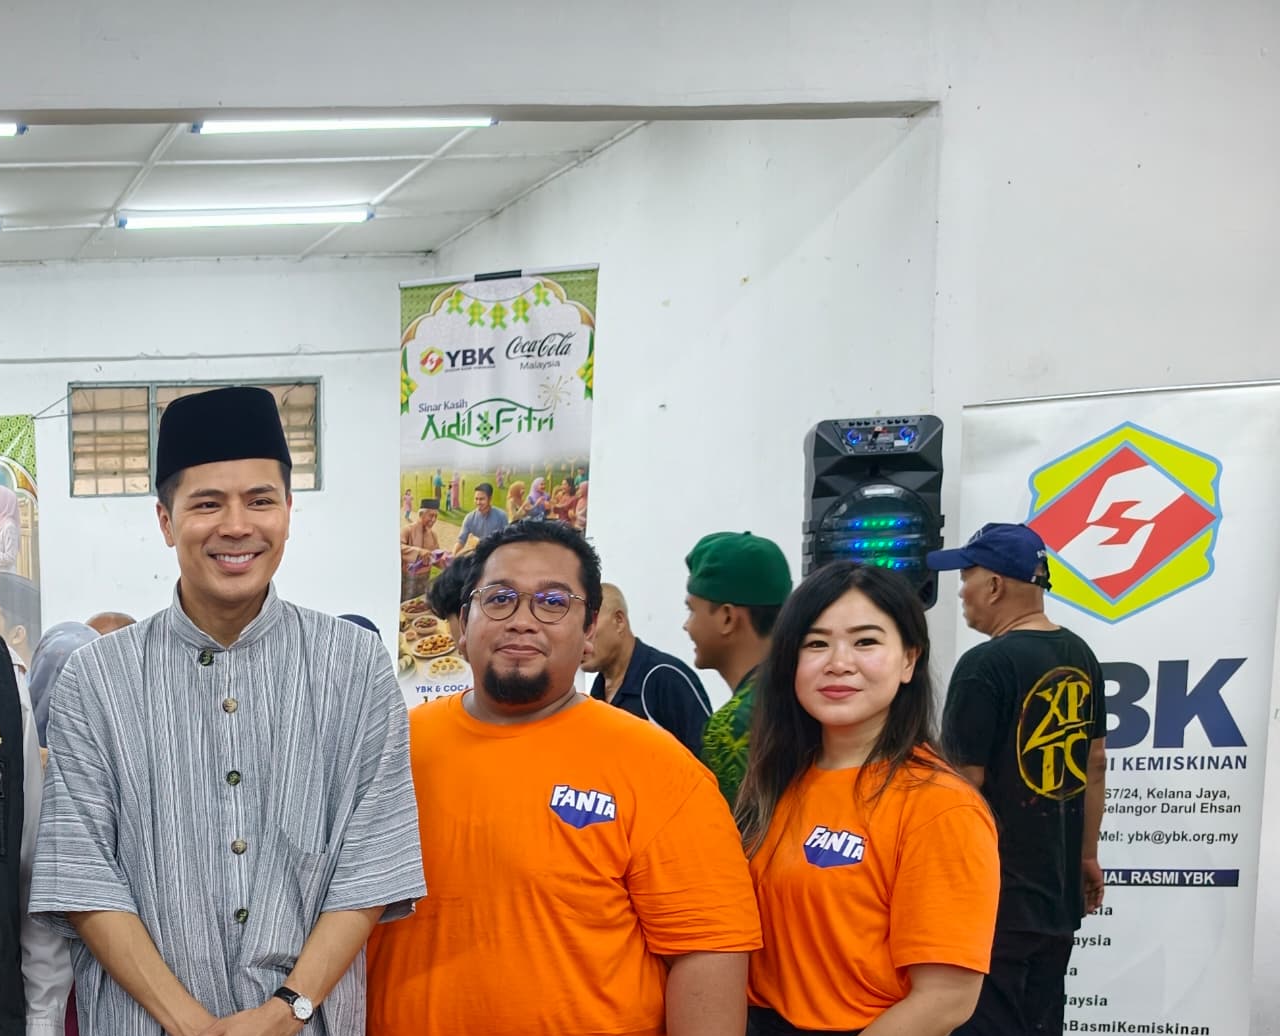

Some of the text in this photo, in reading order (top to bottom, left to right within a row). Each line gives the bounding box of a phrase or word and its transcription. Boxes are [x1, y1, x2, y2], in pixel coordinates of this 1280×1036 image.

[445, 332, 576, 368] YBK Coca-Cola
[520, 360, 561, 370] Malaysia
[418, 399, 468, 413] Sinar Kasih
[495, 407, 554, 434] Fitri
[416, 685, 433, 693] YBK
[1101, 657, 1248, 749] BK
[1122, 755, 1247, 771] KEMISKINAN
[1146, 788, 1192, 799] Kelana
[1195, 788, 1231, 801] Jaya,
[551, 785, 616, 819] FANTA
[1160, 803, 1196, 814] Darul
[1200, 802, 1241, 814] Ehsan
[805, 826, 865, 861] FANTA
[1127, 830, 1239, 844] ybk@ybk.org.my
[1103, 871, 1215, 885] IAL RASMI YBK
[1072, 934, 1111, 948] aysia
[1063, 1020, 1210, 1036] nBasmiKemiskinan
